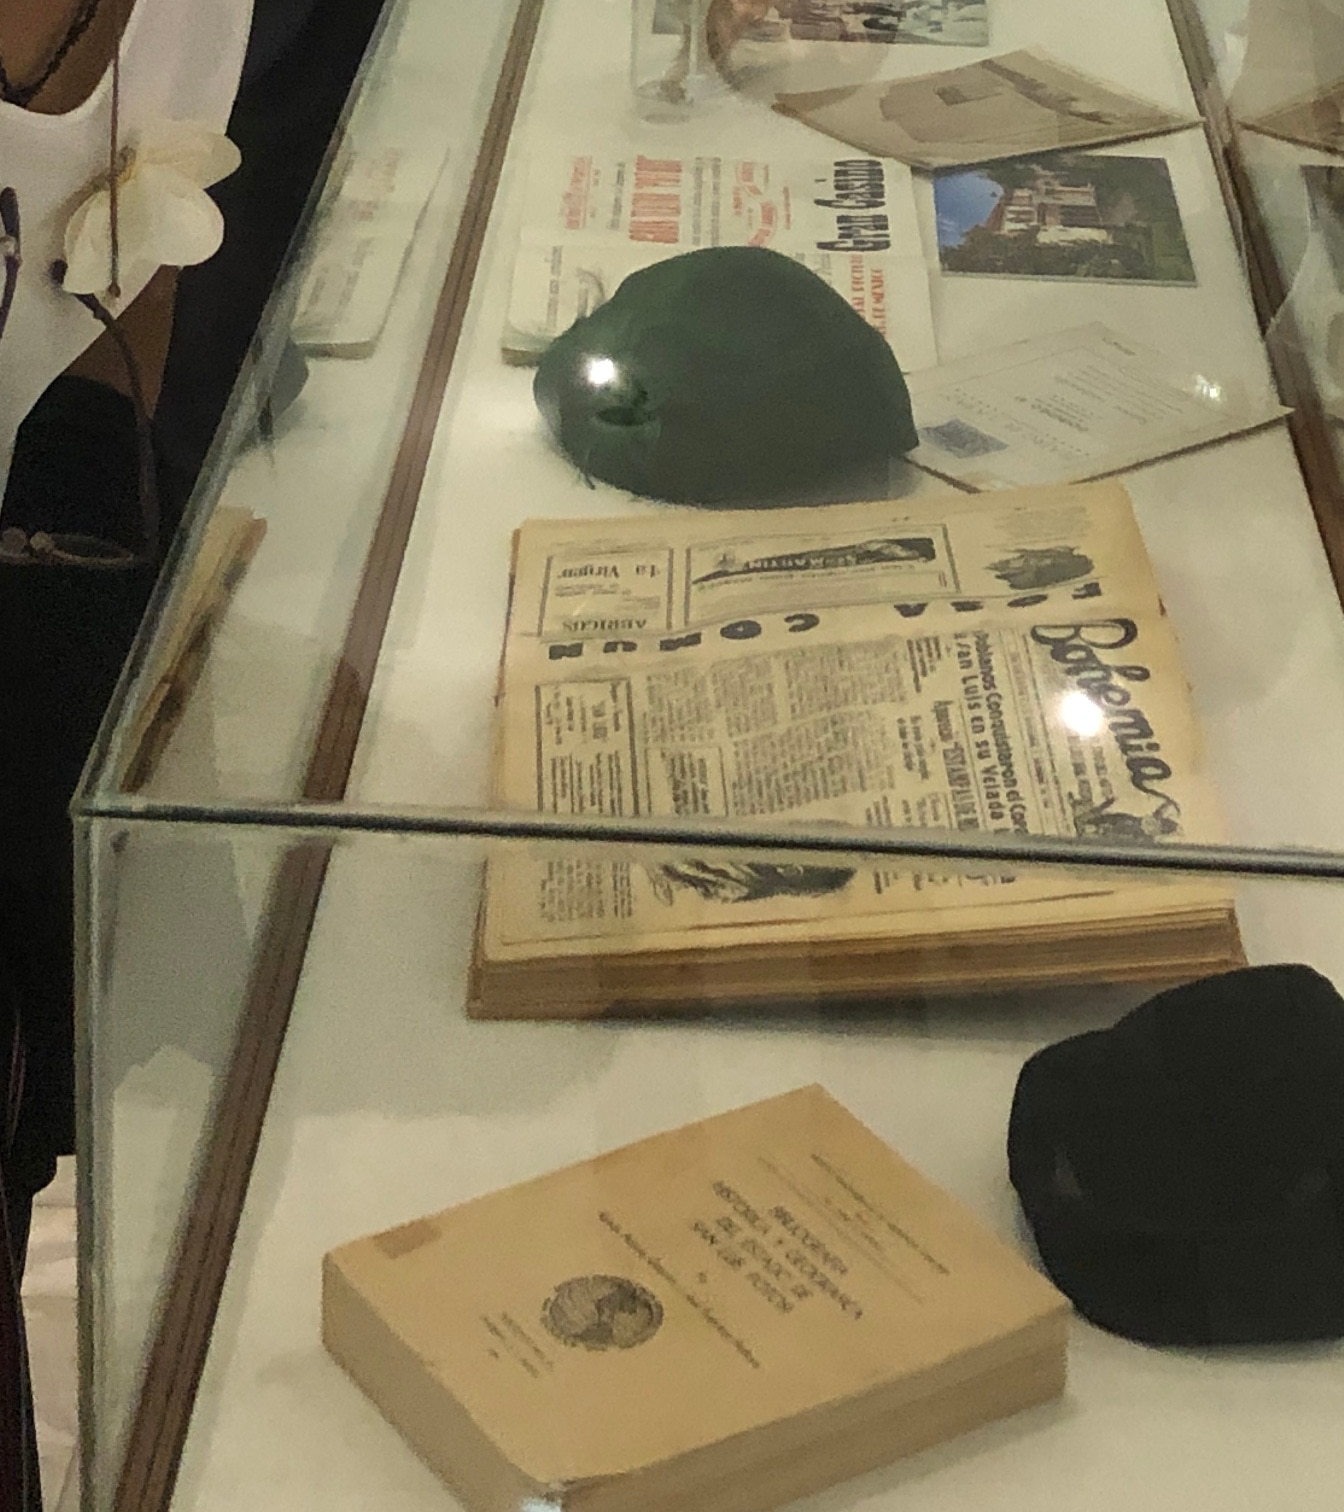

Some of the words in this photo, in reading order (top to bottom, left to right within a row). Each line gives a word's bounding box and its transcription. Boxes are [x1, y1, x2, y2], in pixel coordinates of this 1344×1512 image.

[813, 159, 886, 210] Casino
[816, 214, 891, 252] Gran
[962, 676, 982, 712] Luis
[1030, 618, 1174, 796] Bohemia
[970, 716, 984, 735] en
[986, 692, 1017, 788] Conquistaron
[975, 739, 990, 760] su
[981, 766, 1004, 820] Velada
